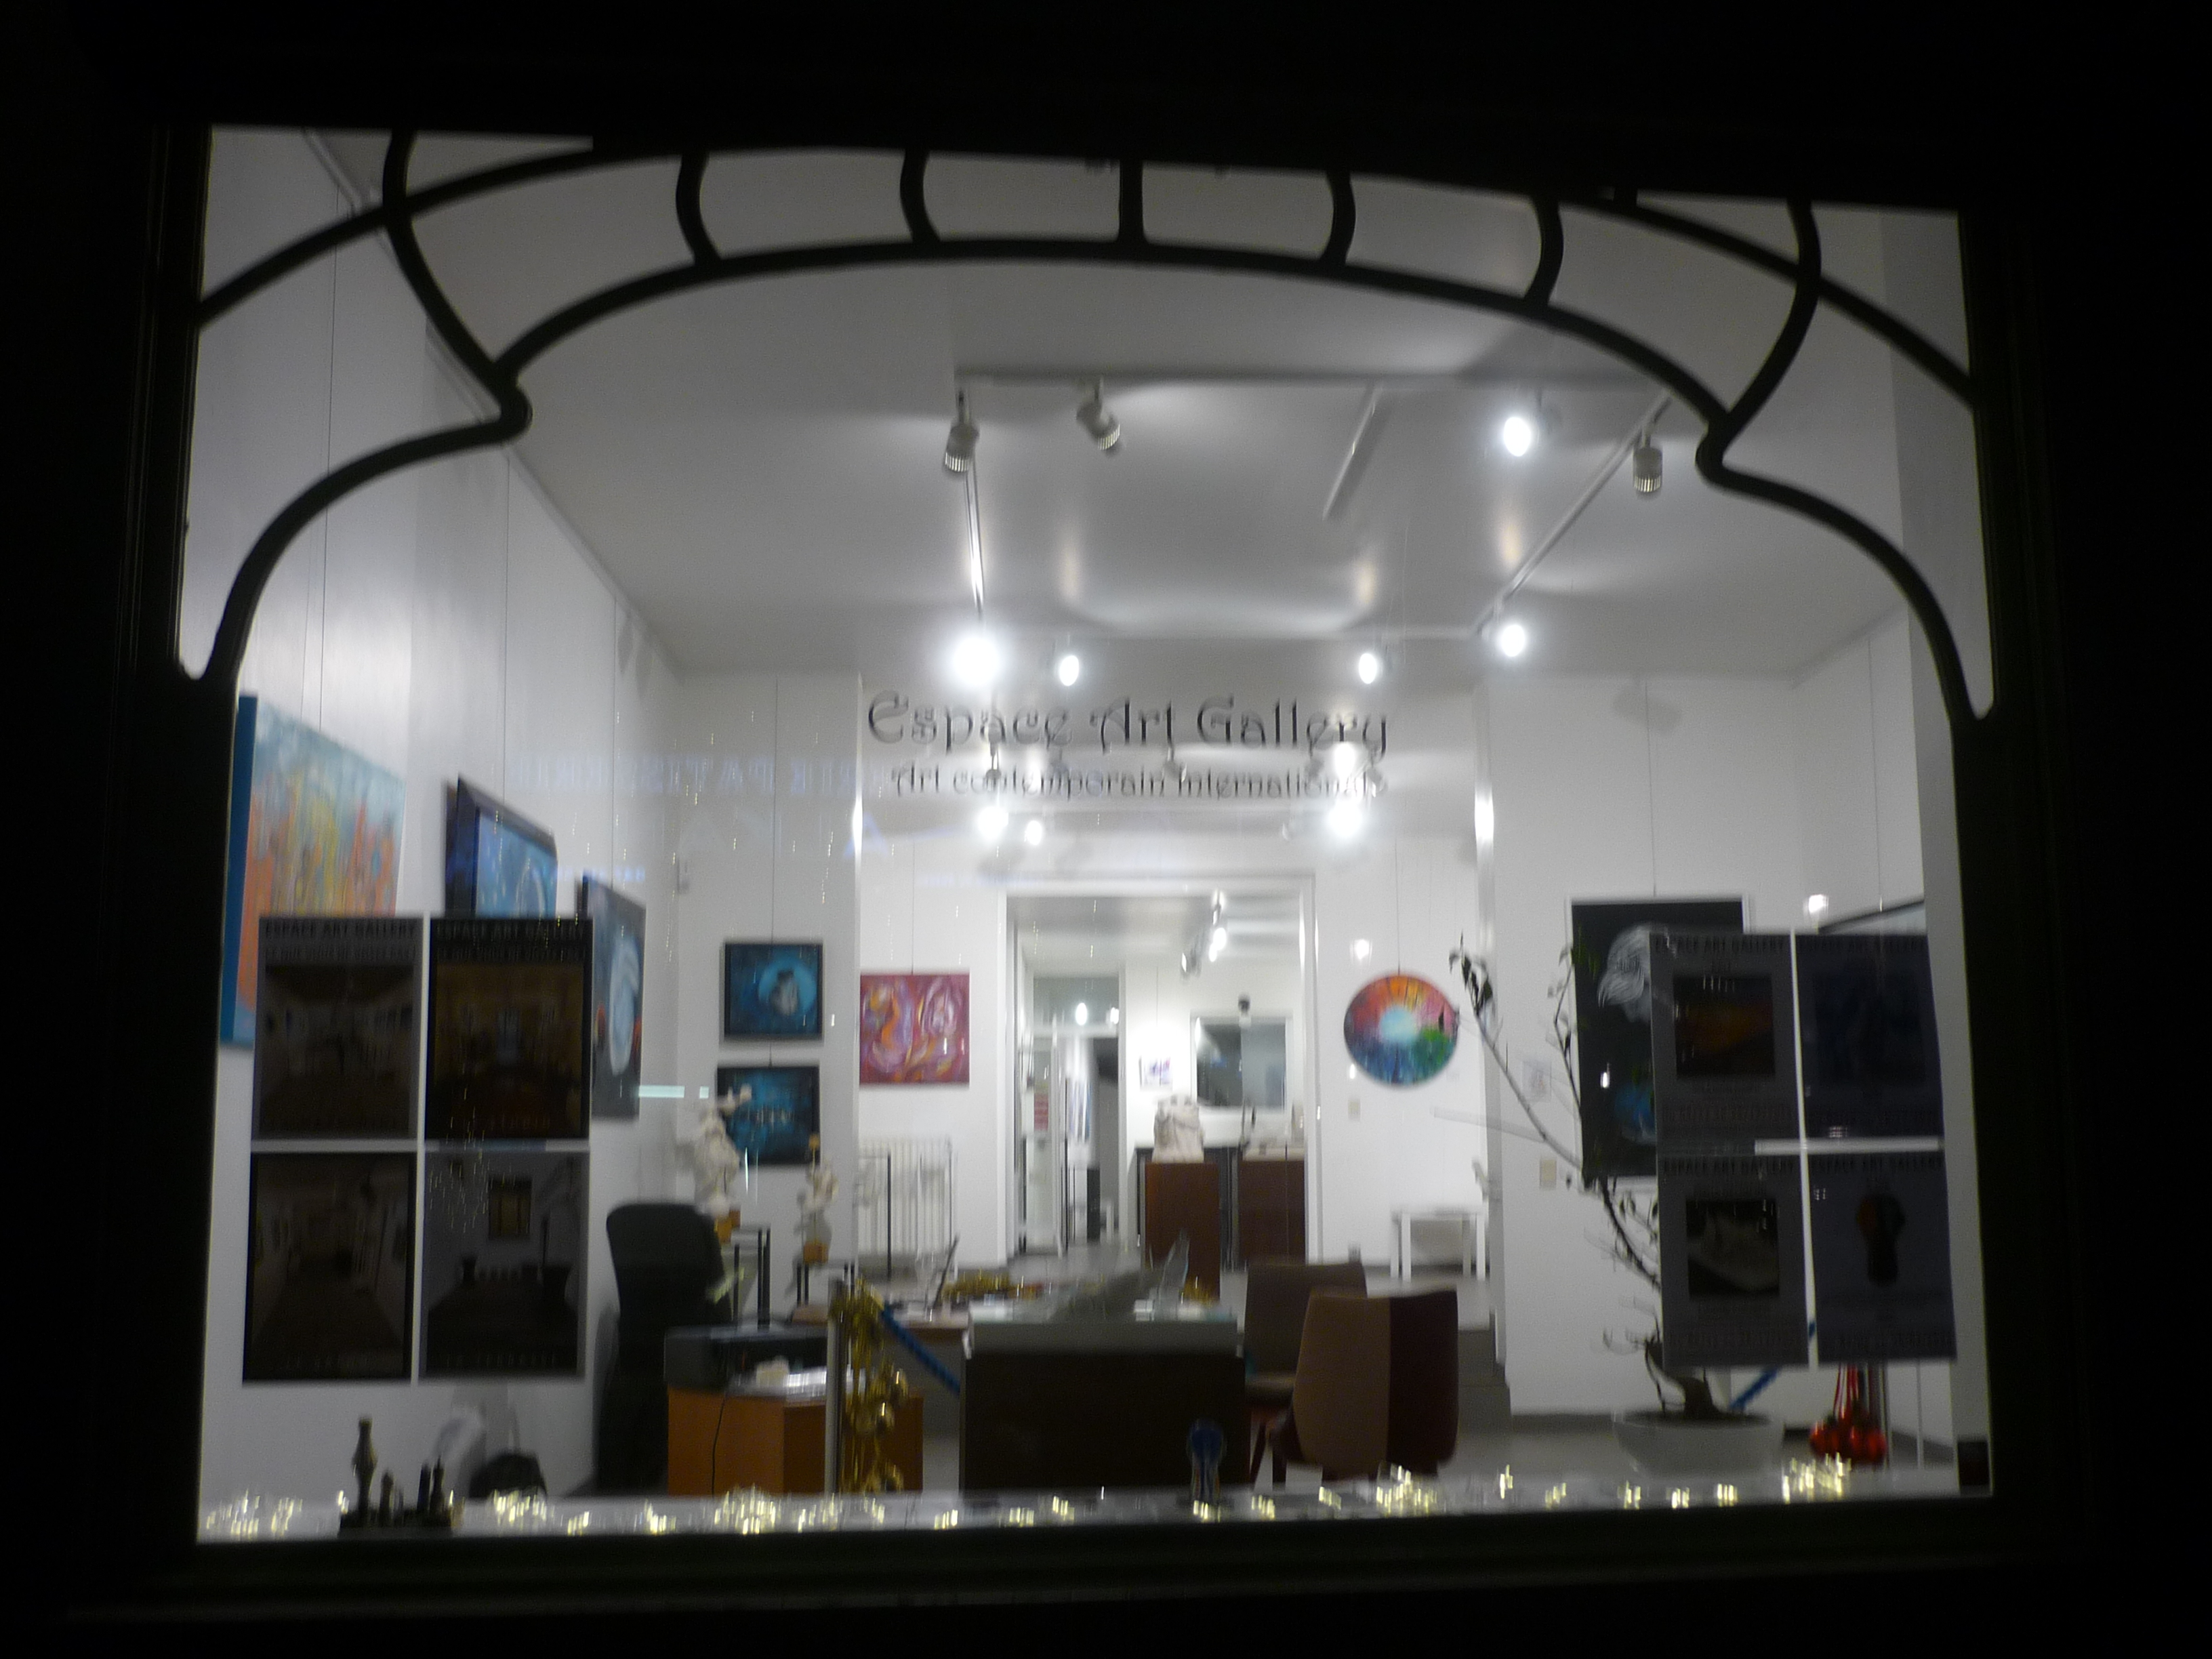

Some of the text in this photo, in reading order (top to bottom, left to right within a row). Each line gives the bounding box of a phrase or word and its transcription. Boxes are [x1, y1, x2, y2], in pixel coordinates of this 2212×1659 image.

[869, 690, 1388, 764] Espace Art Gallery
[891, 760, 940, 797] Art
[953, 766, 1165, 800] contemporain
